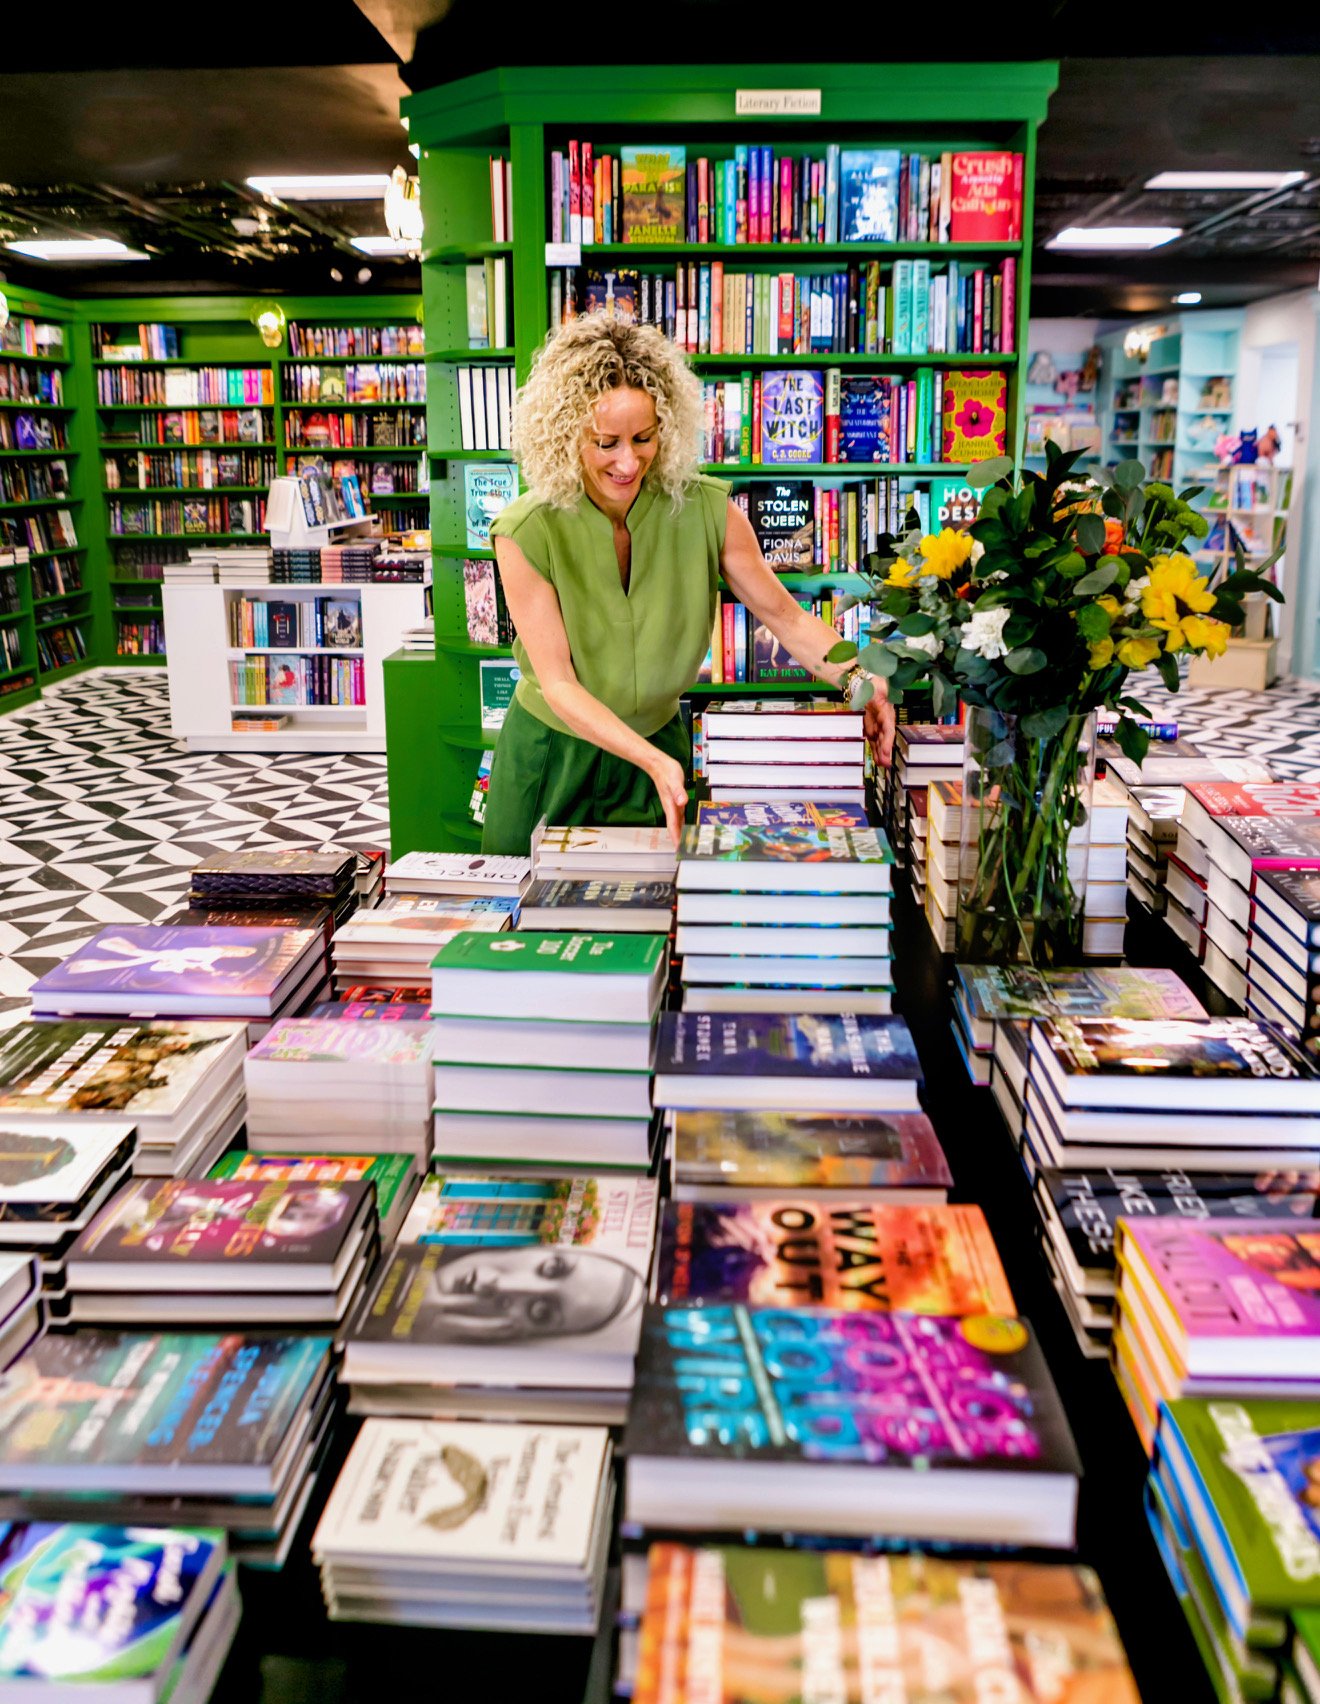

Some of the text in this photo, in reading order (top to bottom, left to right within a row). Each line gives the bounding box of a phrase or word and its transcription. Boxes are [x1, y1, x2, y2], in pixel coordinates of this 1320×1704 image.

[739, 94, 818, 112] Literary Fiction
[953, 156, 1013, 176] Crush
[782, 378, 803, 391] THE
[773, 397, 813, 415] LAST
[765, 421, 819, 438] WITCH
[474, 478, 507, 486] The True
[776, 486, 791, 497] The
[943, 487, 985, 502] HOT
[757, 500, 809, 511] STOLEN
[760, 515, 806, 528] QUEEN
[763, 538, 803, 549] FIONA
[764, 552, 800, 563] DAVIS
[588, 940, 615, 957] The
[873, 1028, 896, 1054] THE
[601, 1189, 629, 1235] STEEL
[1060, 1174, 1115, 1256] THESE
[770, 1208, 824, 1303] OUT
[829, 1206, 892, 1311] WAY
[662, 1305, 771, 1449] WIRE
